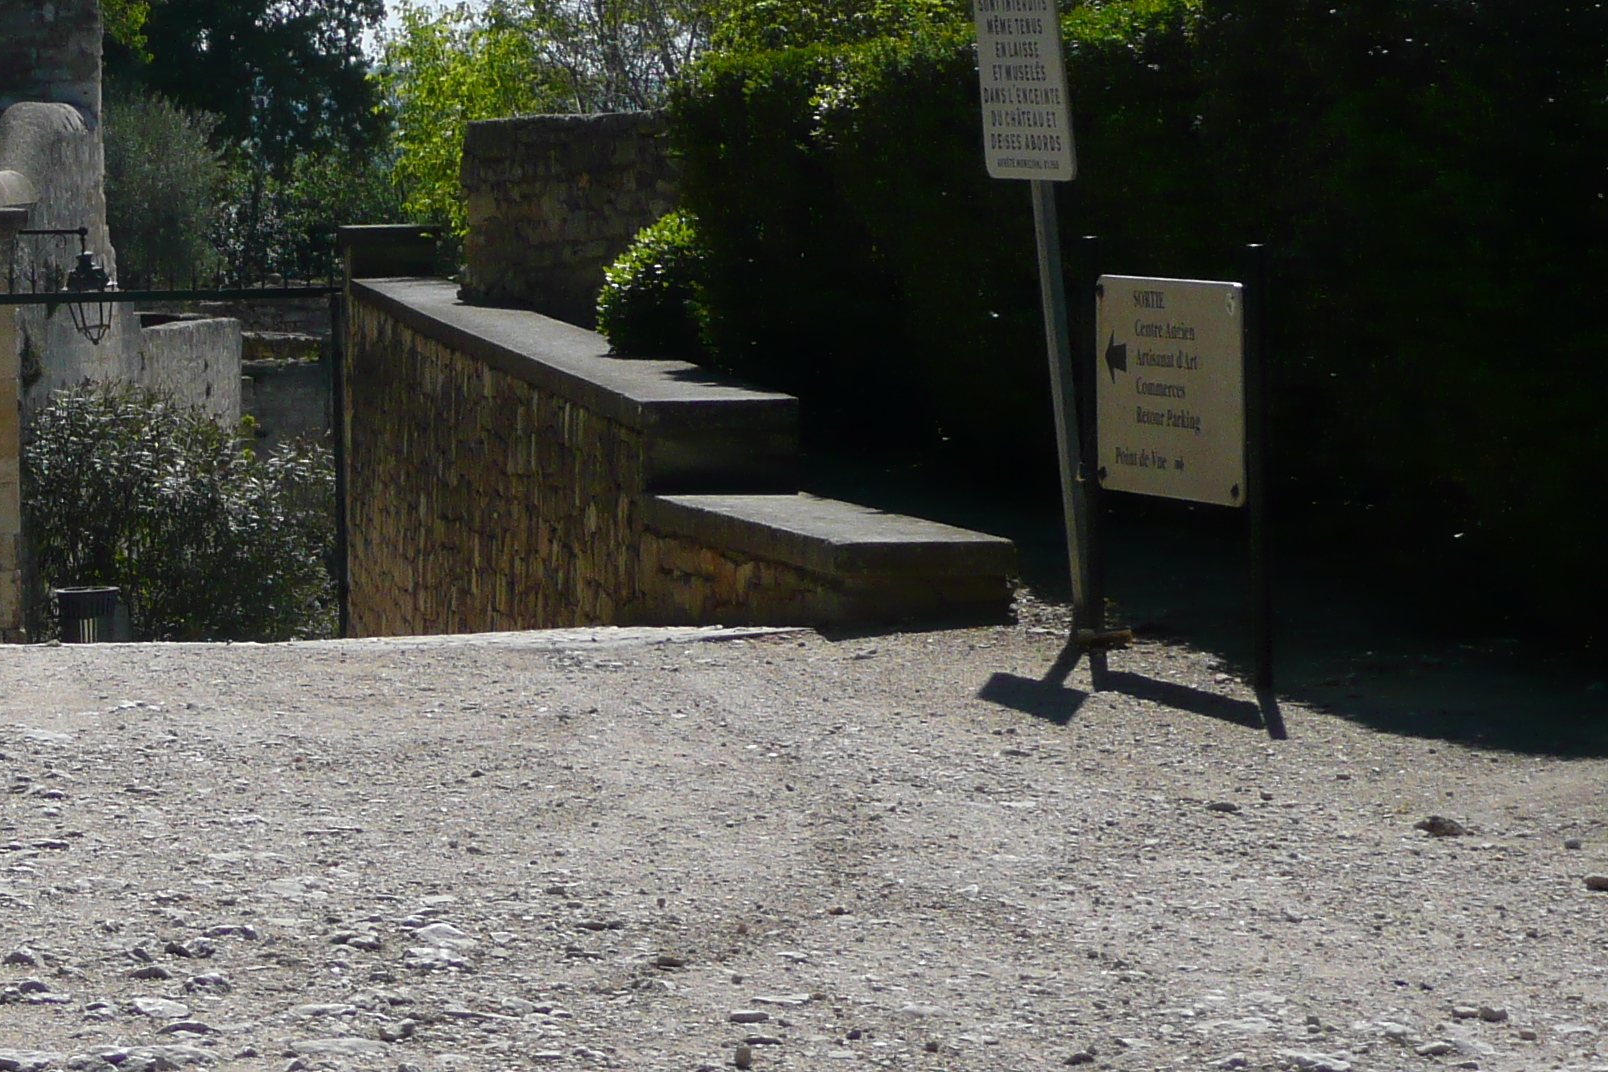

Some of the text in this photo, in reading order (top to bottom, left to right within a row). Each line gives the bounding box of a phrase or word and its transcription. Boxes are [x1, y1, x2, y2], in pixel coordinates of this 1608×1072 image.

[987, 15, 1043, 35] MÊME TENUS
[995, 41, 1040, 59] EN LAISSE
[992, 61, 1047, 82] ET MUSELÉS
[984, 84, 1061, 105] DANS L'ENCEINTE
[991, 107, 1057, 128] DU CHÂTEAU ET
[991, 133, 1061, 152] DE SES ABORDS
[1133, 290, 1165, 309] SORTIE
[1135, 318, 1195, 341] Centre Ancien
[1136, 348, 1198, 370] Artisanat d'Art
[1136, 376, 1186, 399] Commerces
[1136, 405, 1201, 436] Retour Parking
[1115, 446, 1167, 469] Point de Vue
